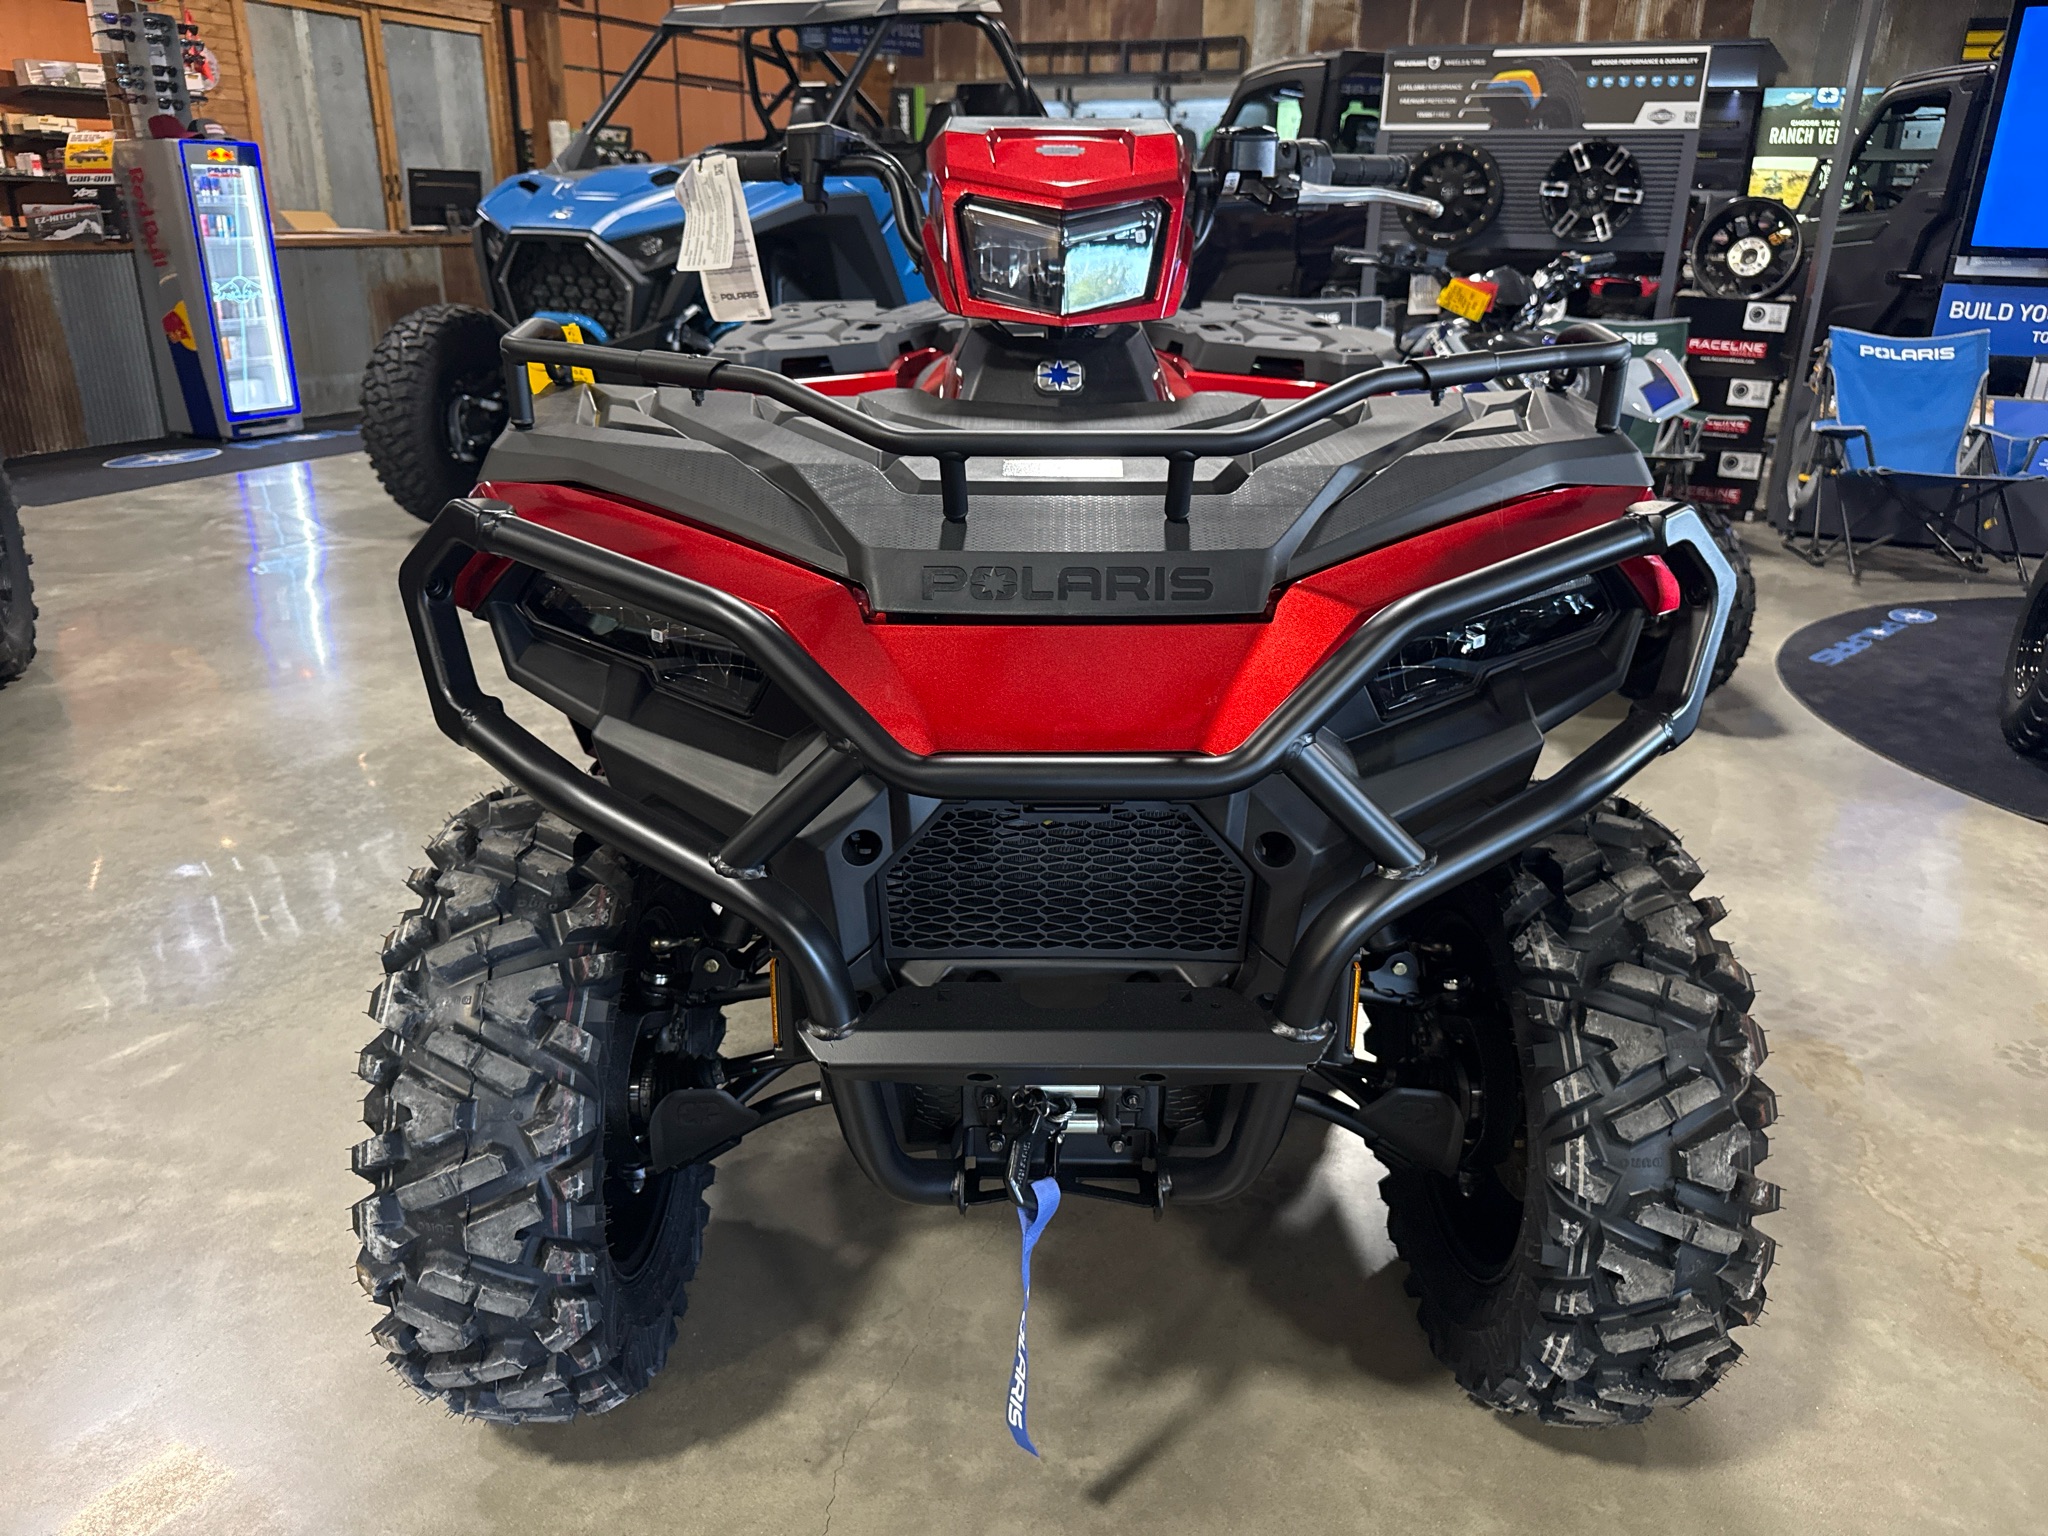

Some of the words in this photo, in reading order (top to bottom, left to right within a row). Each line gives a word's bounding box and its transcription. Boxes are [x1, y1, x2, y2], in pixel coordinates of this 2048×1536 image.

[1790, 119, 1820, 127] CHOOSE
[1768, 127, 1815, 145] RANCH
[129, 167, 154, 216] Red
[34, 212, 77, 225] EZ-HITCH
[720, 291, 759, 301] POLARIS
[1949, 301, 2014, 321] BUILD
[2020, 303, 2048, 323] YO
[1689, 338, 1767, 354] RACELINE
[1859, 344, 1955, 361] POLARIS
[921, 565, 1215, 602] POLARIS
